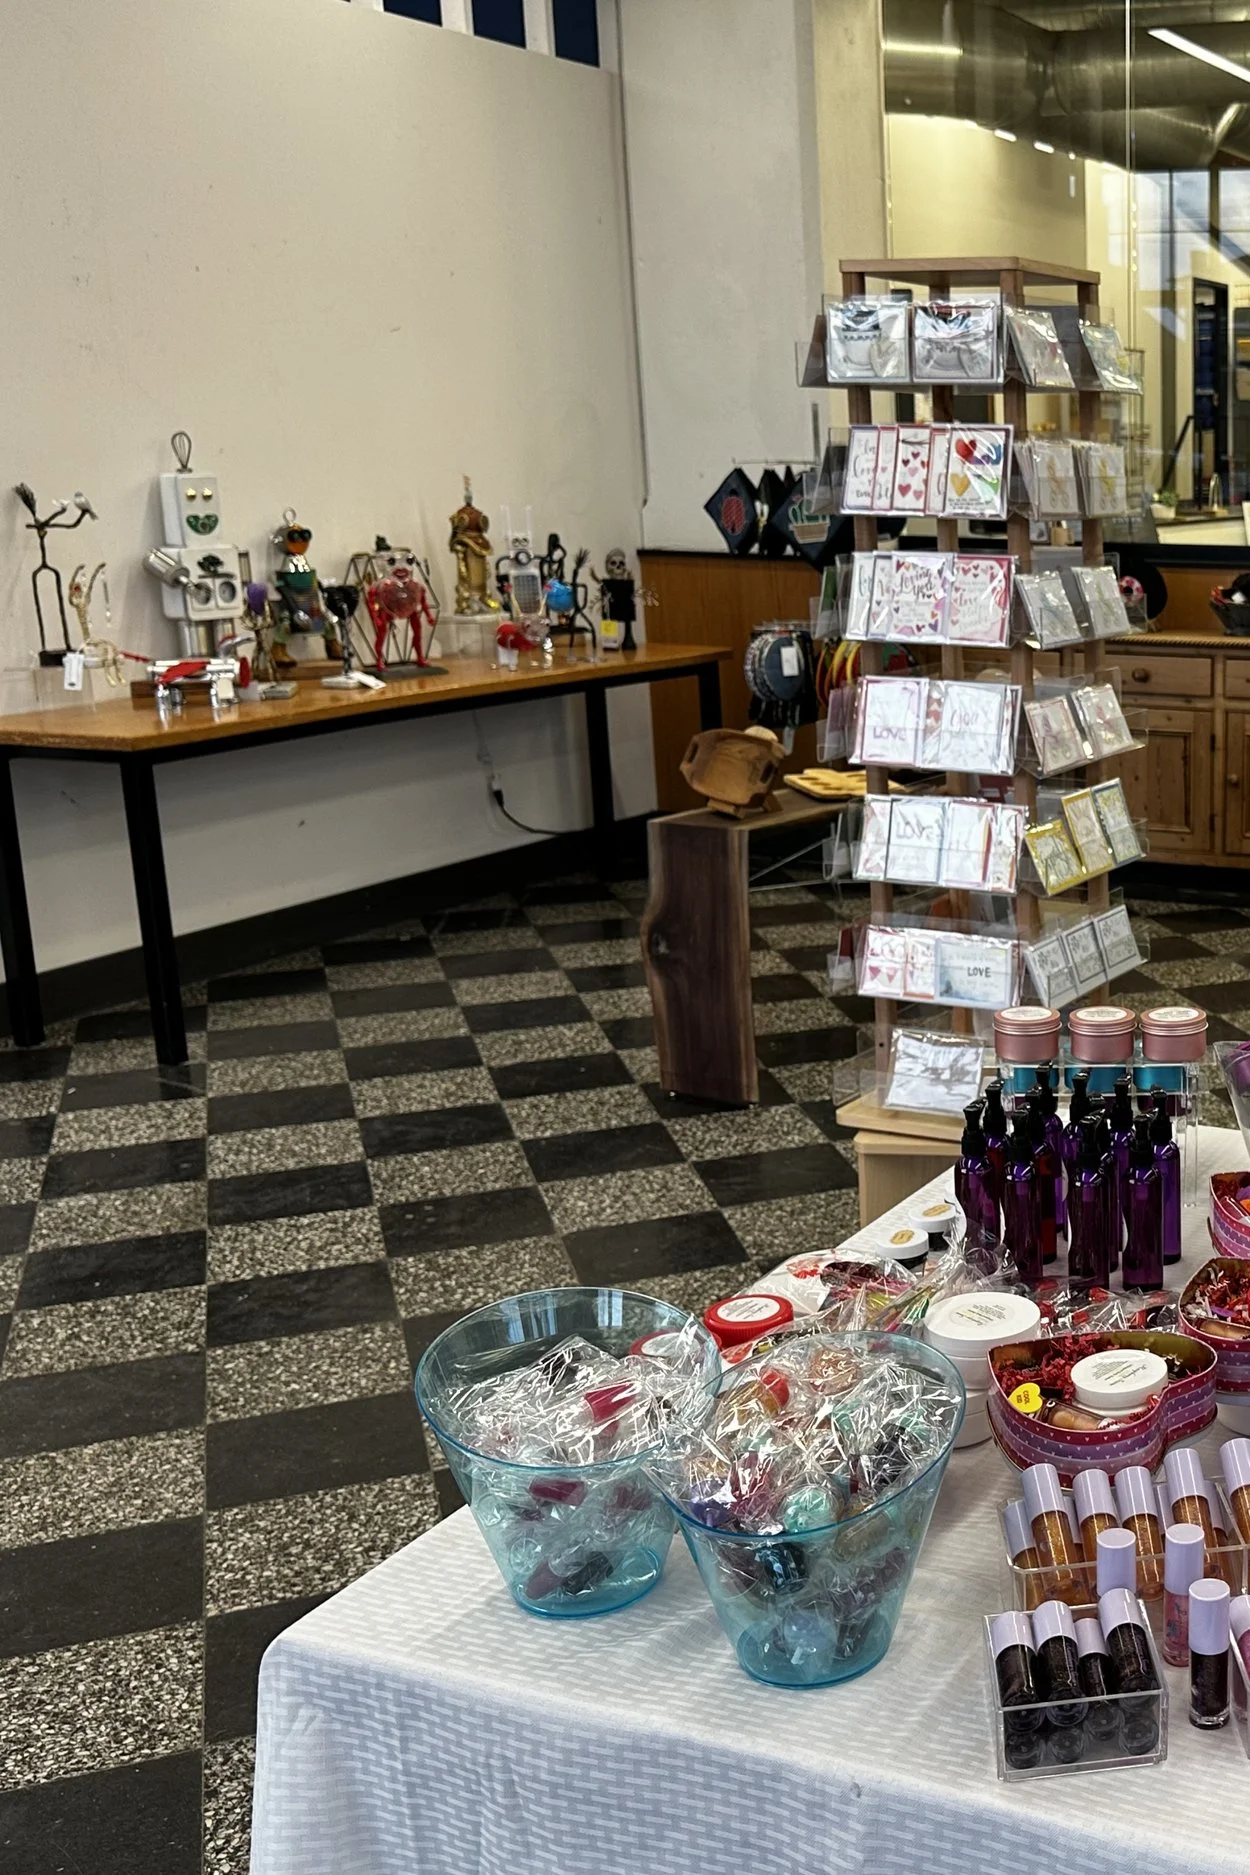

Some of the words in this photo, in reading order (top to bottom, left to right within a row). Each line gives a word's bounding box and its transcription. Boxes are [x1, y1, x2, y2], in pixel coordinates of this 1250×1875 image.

[900, 568, 932, 594] Loving
[913, 581, 936, 600] you
[873, 727, 906, 741] LOVE
[967, 966, 991, 978] LOVE
[1022, 1390, 1030, 1405] COOL
